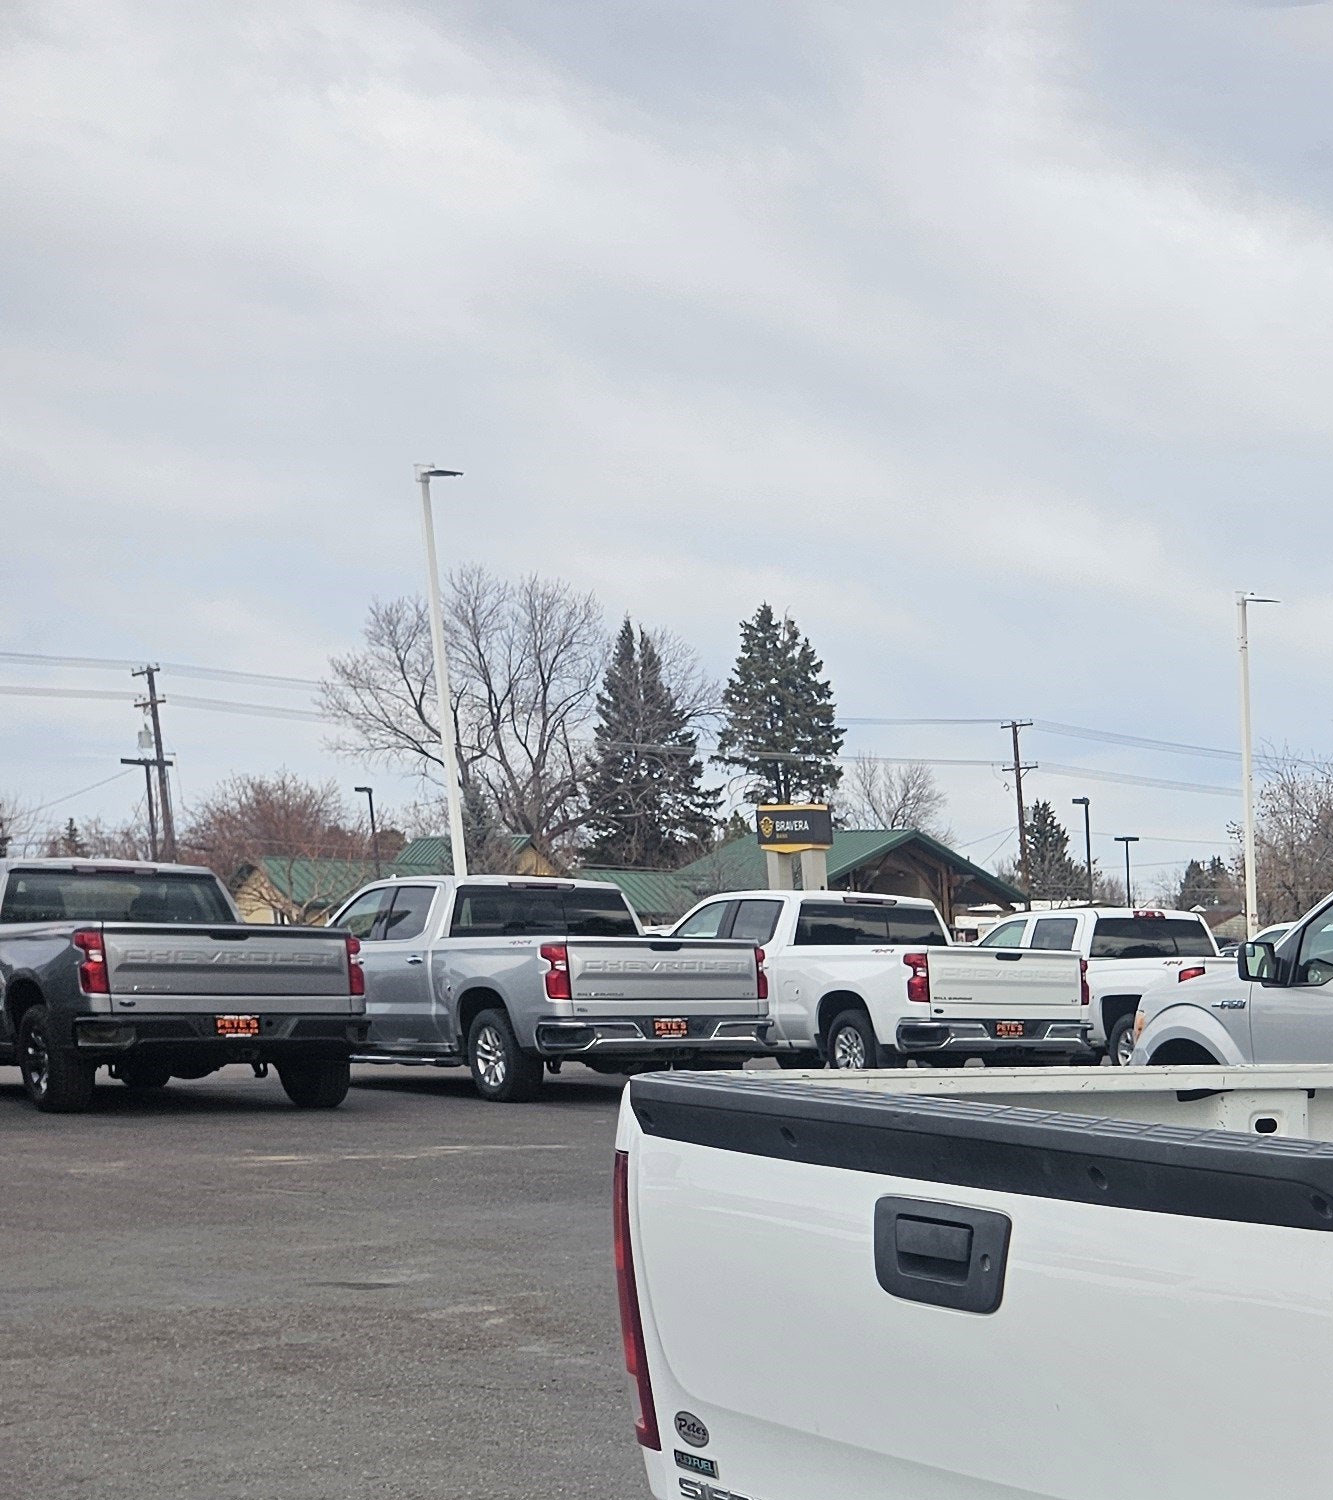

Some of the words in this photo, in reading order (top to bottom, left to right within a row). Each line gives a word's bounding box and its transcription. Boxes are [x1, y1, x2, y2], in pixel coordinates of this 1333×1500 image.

[775, 820, 810, 831] BRAVERA
[123, 949, 336, 966] CHEVROLET
[582, 960, 748, 973] CHEVROLET
[942, 967, 1072, 980] CHEVROLET
[217, 1019, 258, 1028] PETE'S
